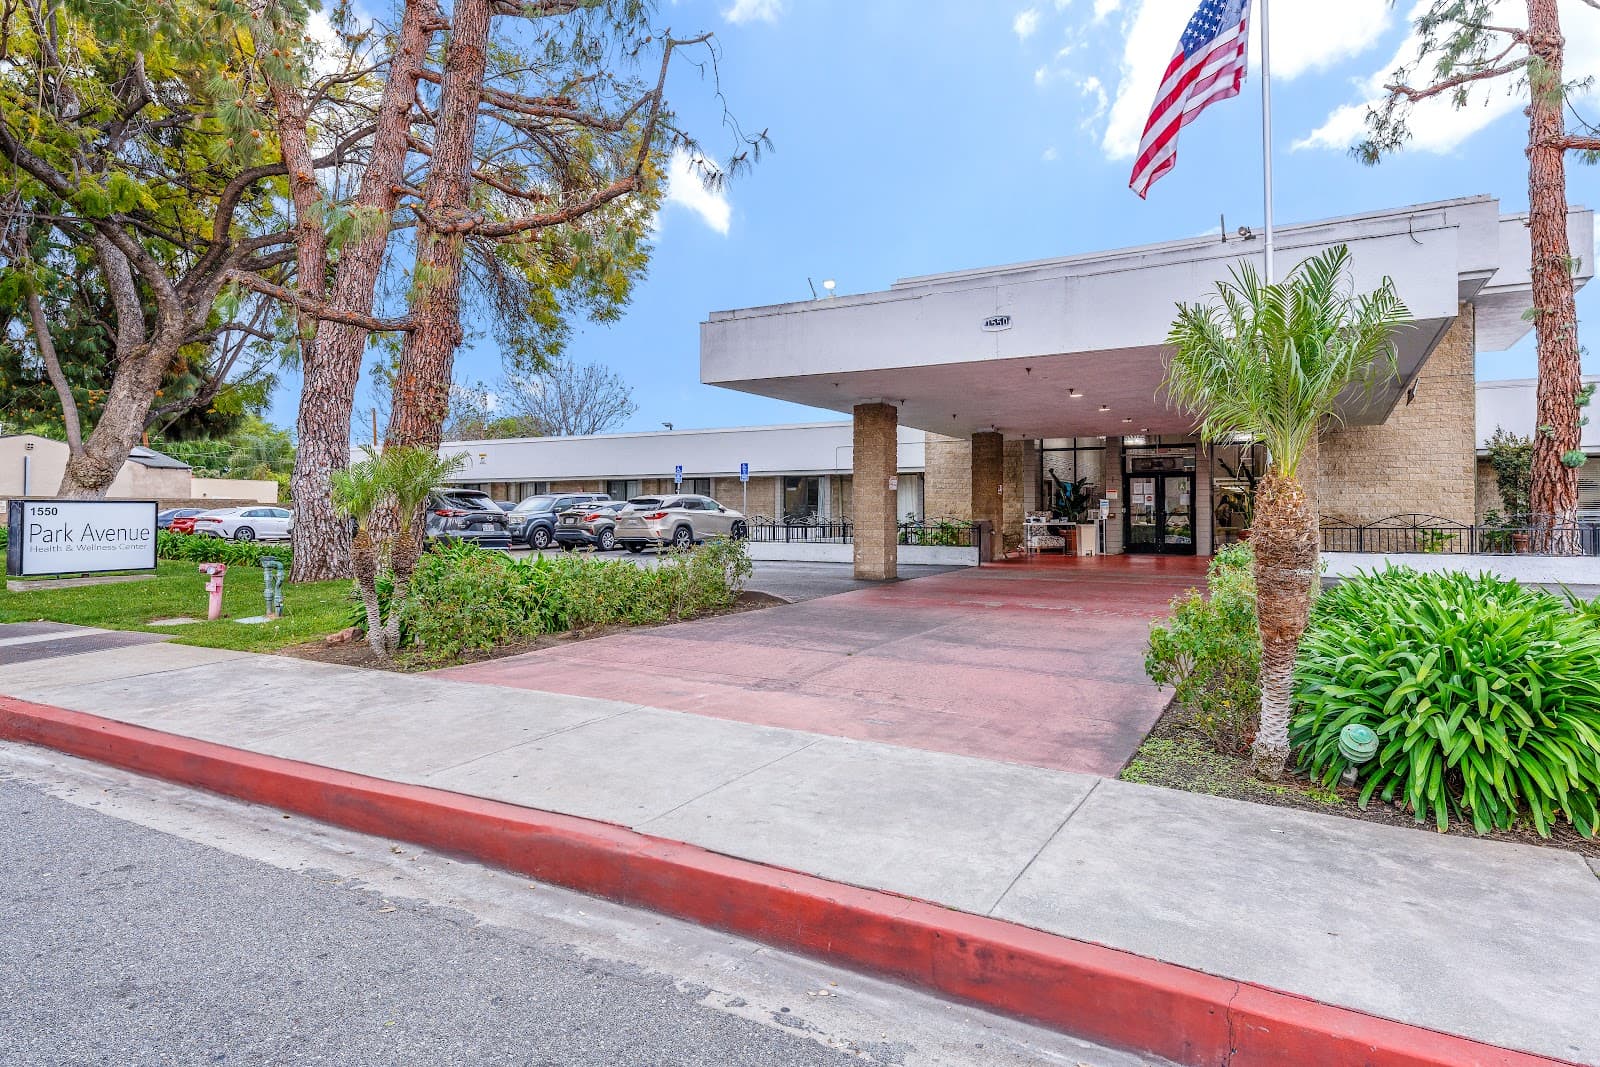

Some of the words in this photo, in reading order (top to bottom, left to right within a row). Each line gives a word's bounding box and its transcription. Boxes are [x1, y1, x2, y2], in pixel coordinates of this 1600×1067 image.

[30, 507, 58, 516] 1550
[29, 522, 73, 543] Park
[80, 523, 150, 542] Avenue
[29, 544, 62, 553] Health
[65, 544, 74, 552] &
[76, 543, 117, 552] Wellness
